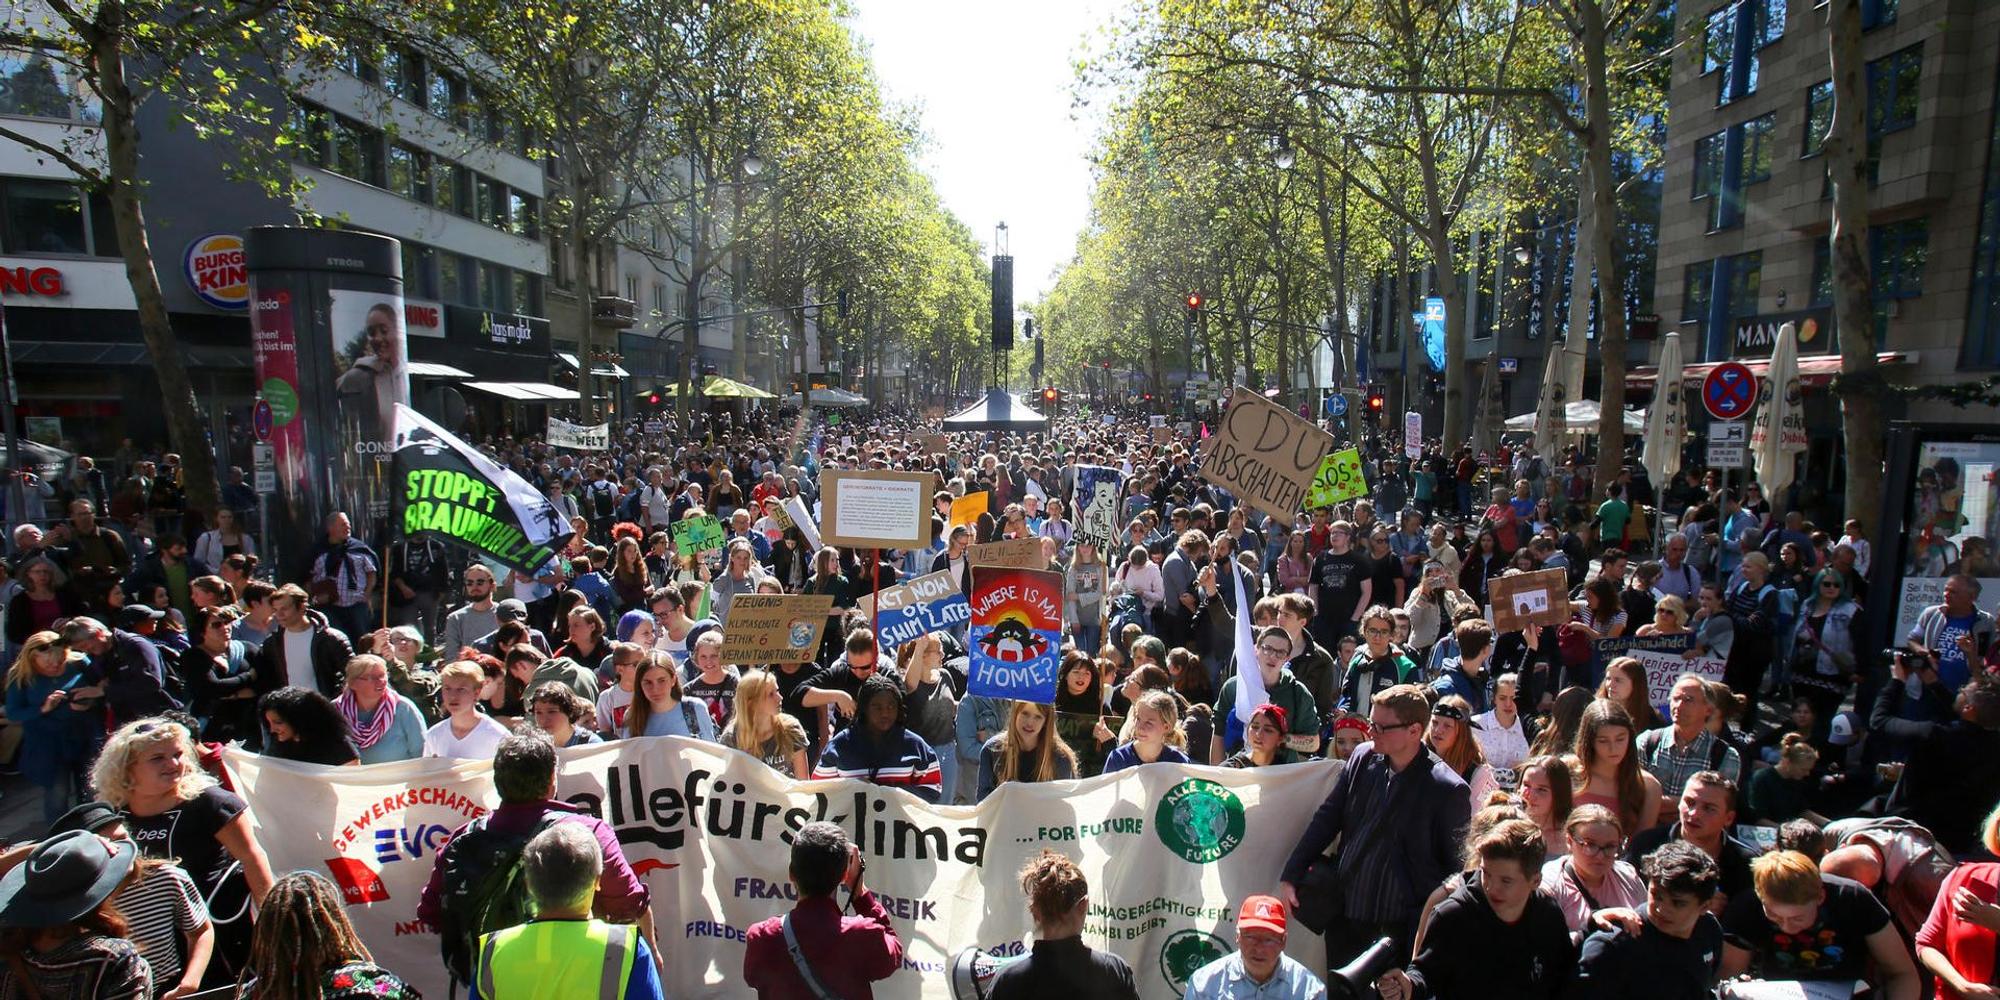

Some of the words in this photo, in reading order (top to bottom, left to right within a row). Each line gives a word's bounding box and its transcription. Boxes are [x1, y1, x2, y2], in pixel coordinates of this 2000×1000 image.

[199, 265, 248, 292] KIN
[1737, 320, 1782, 348] MAN
[576, 435, 605, 447] WELT
[1228, 401, 1326, 471] CDU
[1201, 439, 1306, 515] ABSCHALTEN
[672, 522, 688, 535] DIE
[910, 576, 951, 600] NOW
[733, 597, 783, 608] ZEUGNIS
[902, 601, 932, 617] OR
[972, 585, 1018, 617] WHERE
[1024, 587, 1039, 603] IS
[1038, 597, 1060, 621] MY
[727, 620, 780, 628] KLIMASCHUTZ
[881, 617, 928, 647] SWIM
[724, 634, 756, 645] ETHIK
[760, 634, 768, 645] 6
[722, 649, 799, 660] VERANTWORTUNG
[802, 648, 811, 660] 6
[976, 657, 1053, 688] HOME?
[1649, 671, 1680, 687] PLAS
[1167, 781, 1196, 806] ALLE
[1205, 783, 1230, 801] FOR
[333, 787, 487, 852] GEWERKSCHAFTE
[1038, 826, 1076, 842] FOR
[1081, 817, 1144, 837] FUTURE
[1186, 833, 1238, 861] FUTURE
[735, 877, 798, 901] FRAU
[1087, 897, 1234, 923] LIMAGERECHTIGKEIT.
[686, 920, 747, 943] FRIEDE
[1127, 917, 1168, 941] BLEIBT
